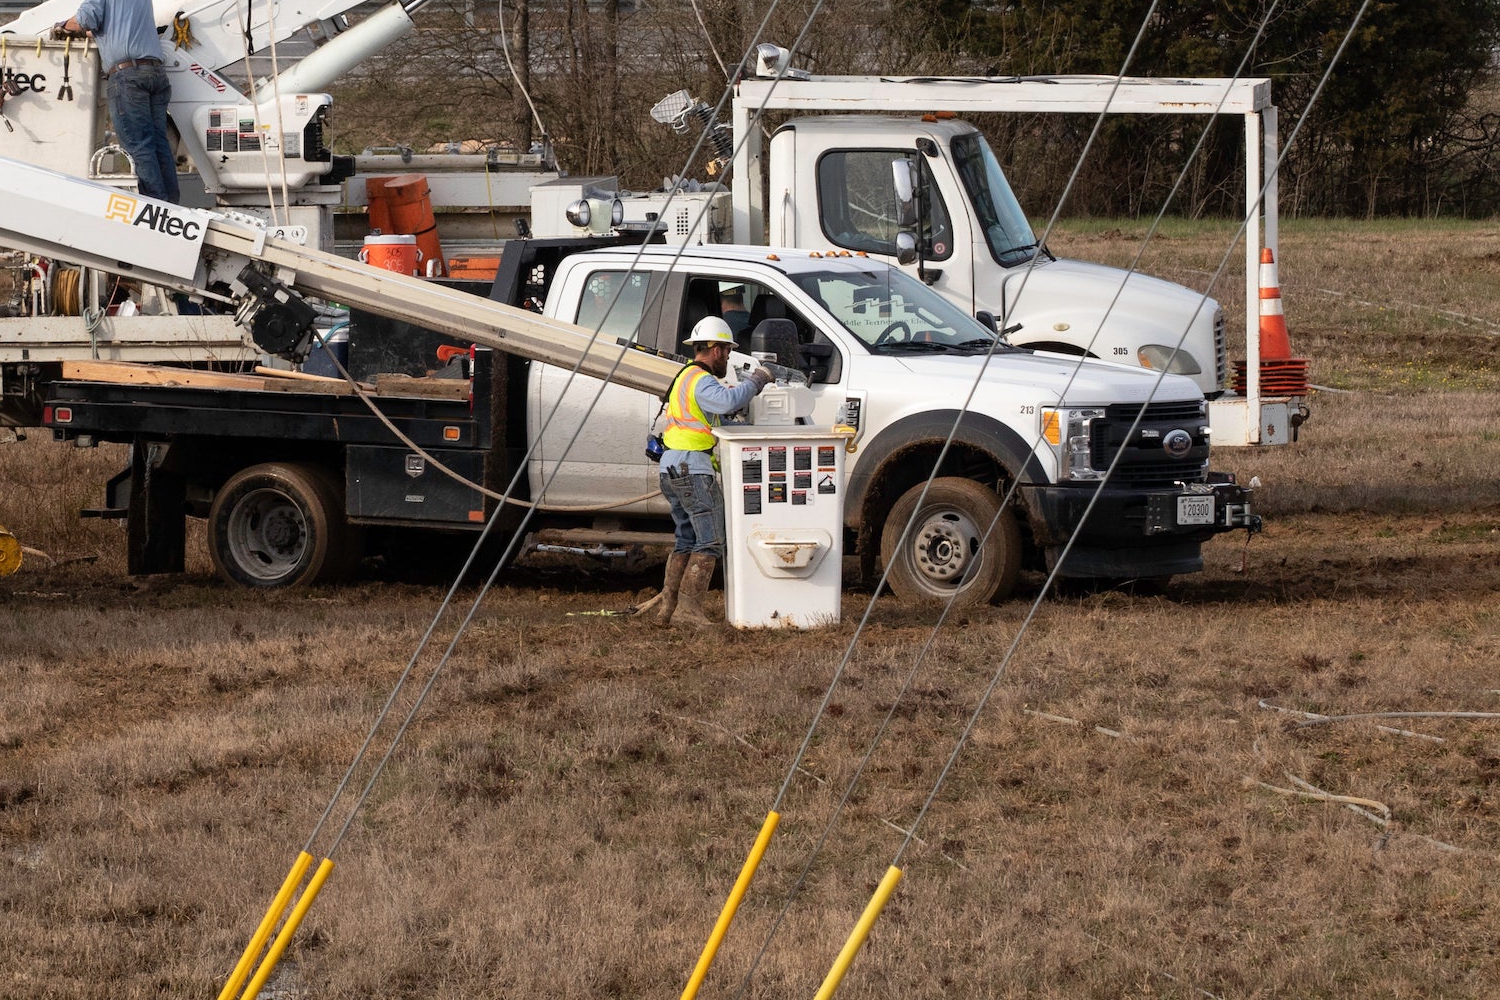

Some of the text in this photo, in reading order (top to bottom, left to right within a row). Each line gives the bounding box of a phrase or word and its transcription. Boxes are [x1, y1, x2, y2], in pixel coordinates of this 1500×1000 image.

[132, 203, 200, 241] Altec
[1112, 346, 1129, 356] 305
[1019, 405, 1035, 415] 213
